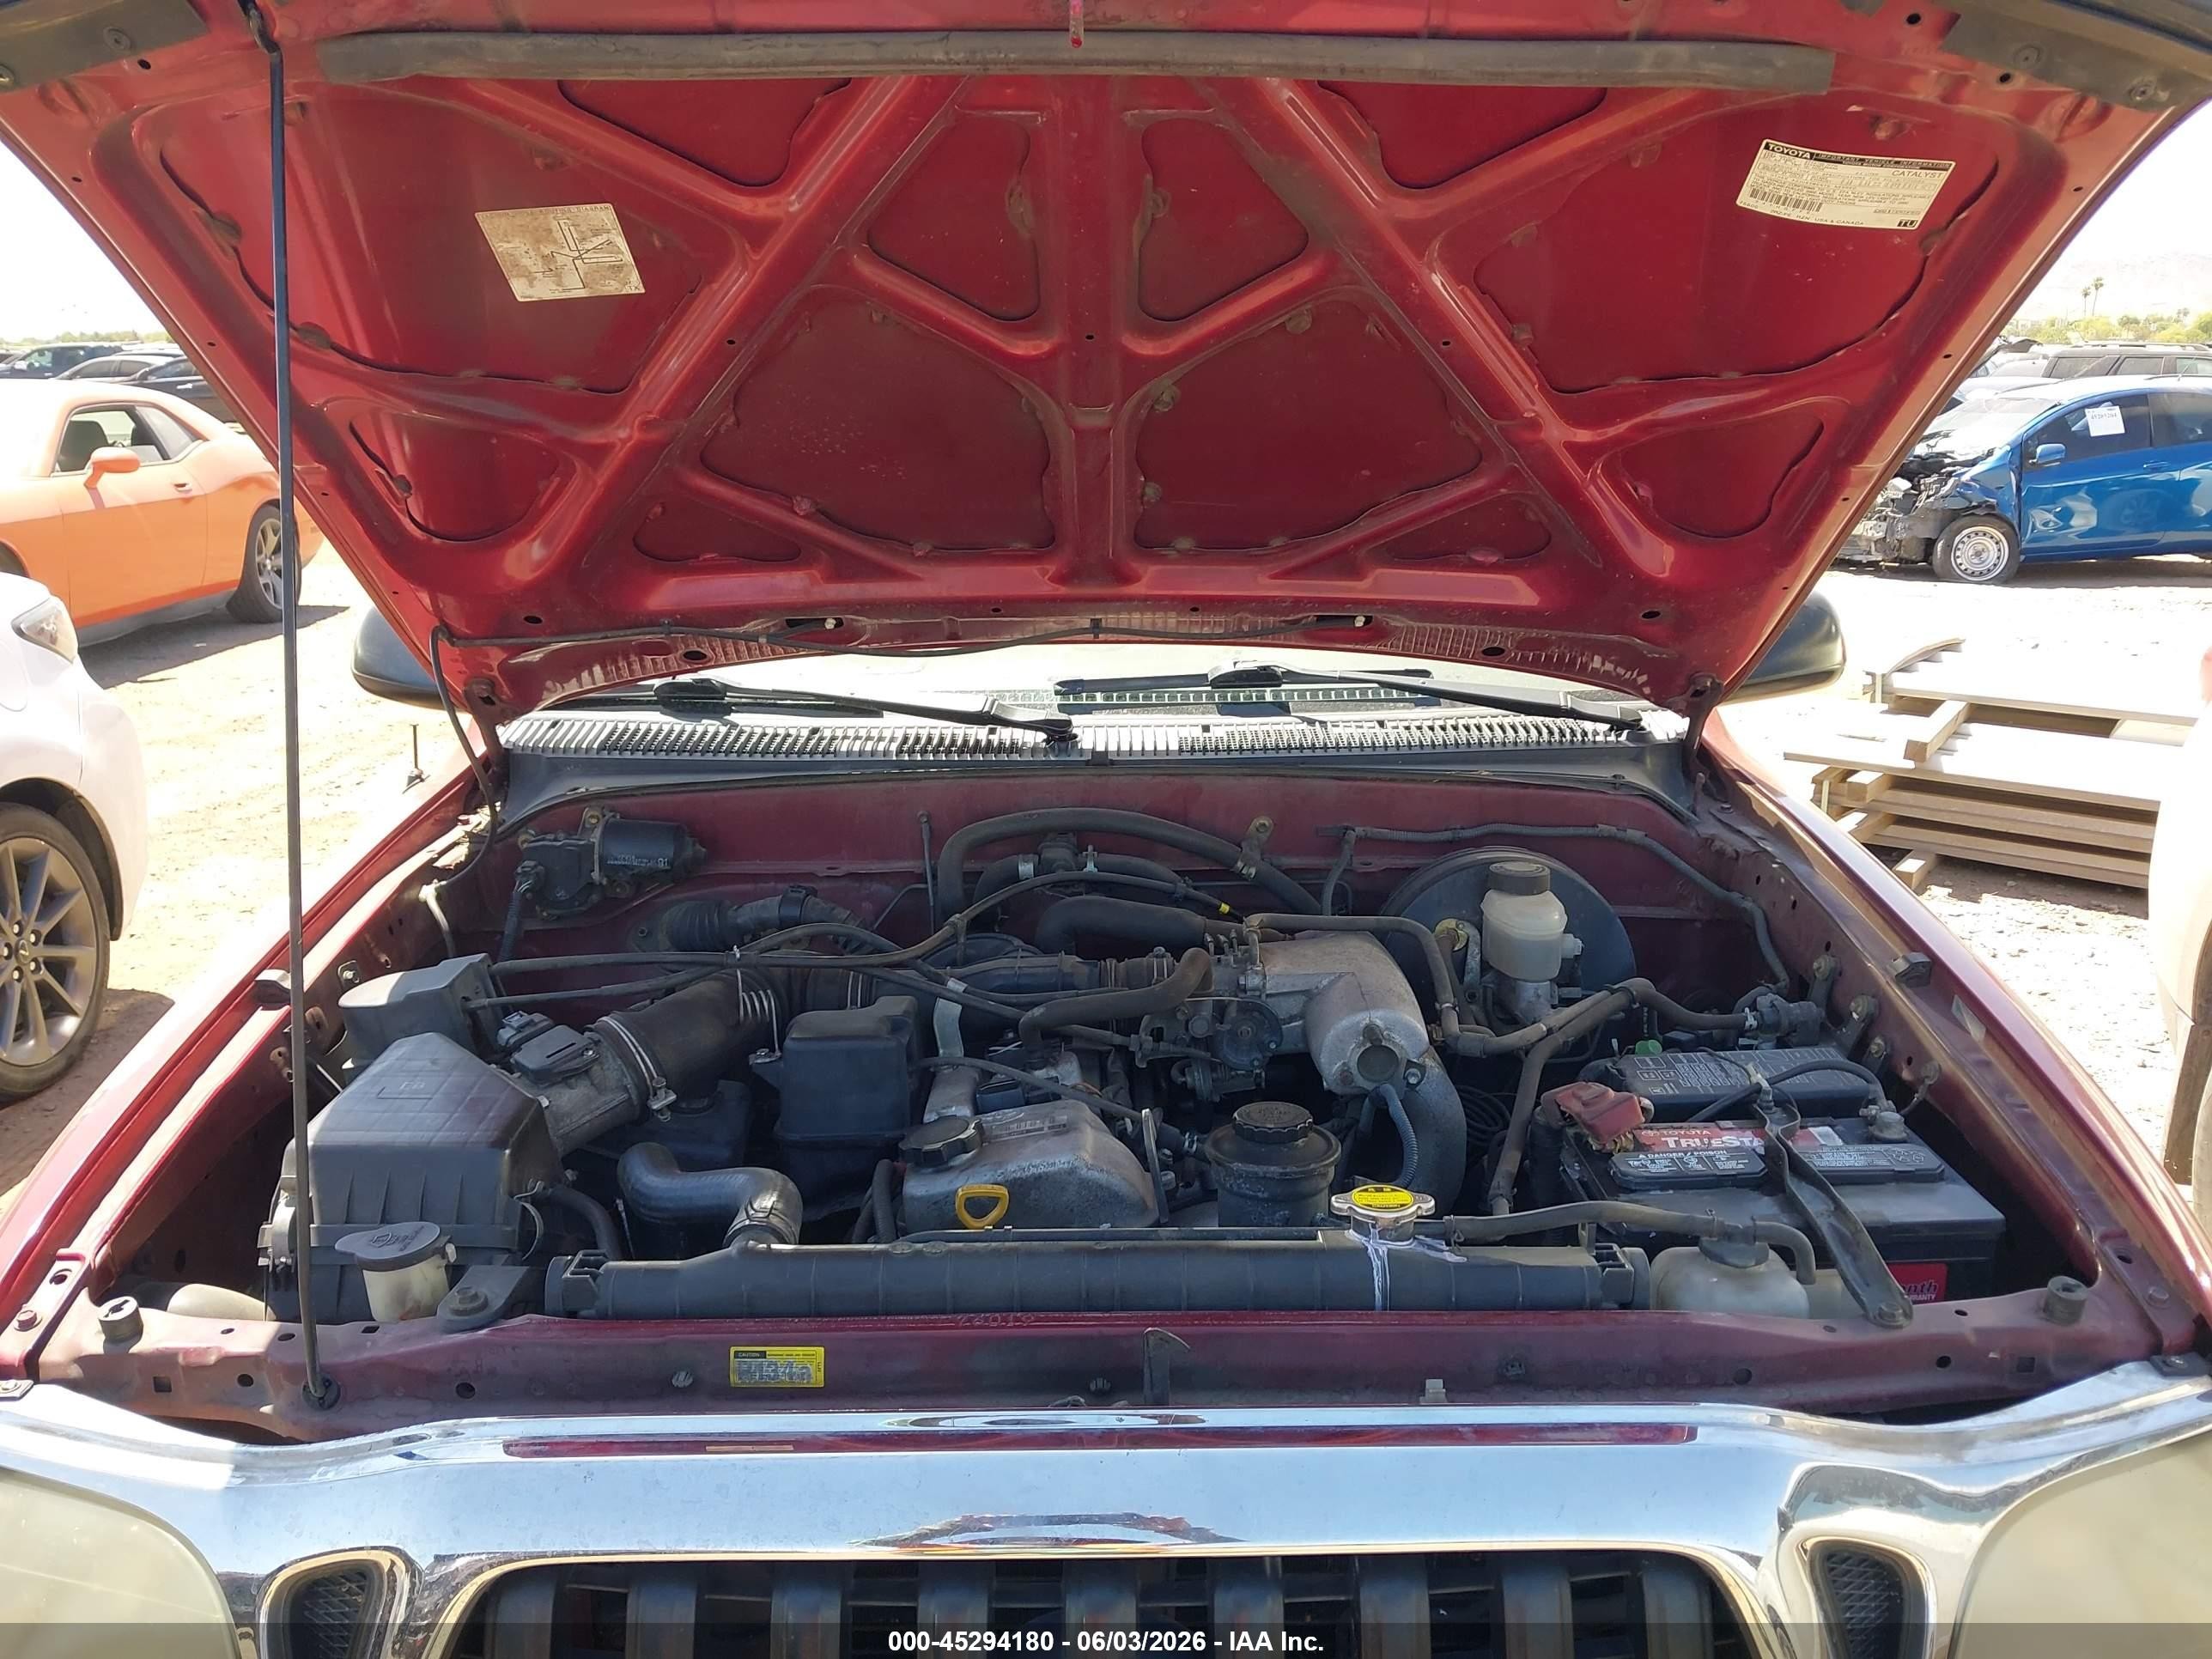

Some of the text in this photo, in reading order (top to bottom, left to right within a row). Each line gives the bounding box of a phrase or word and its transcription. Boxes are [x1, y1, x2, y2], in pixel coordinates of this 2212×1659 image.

[1768, 143, 1811, 160] TOYOTA
[1892, 170, 1944, 179] CATALYST
[1662, 1135, 1765, 1149] TRUESTA
